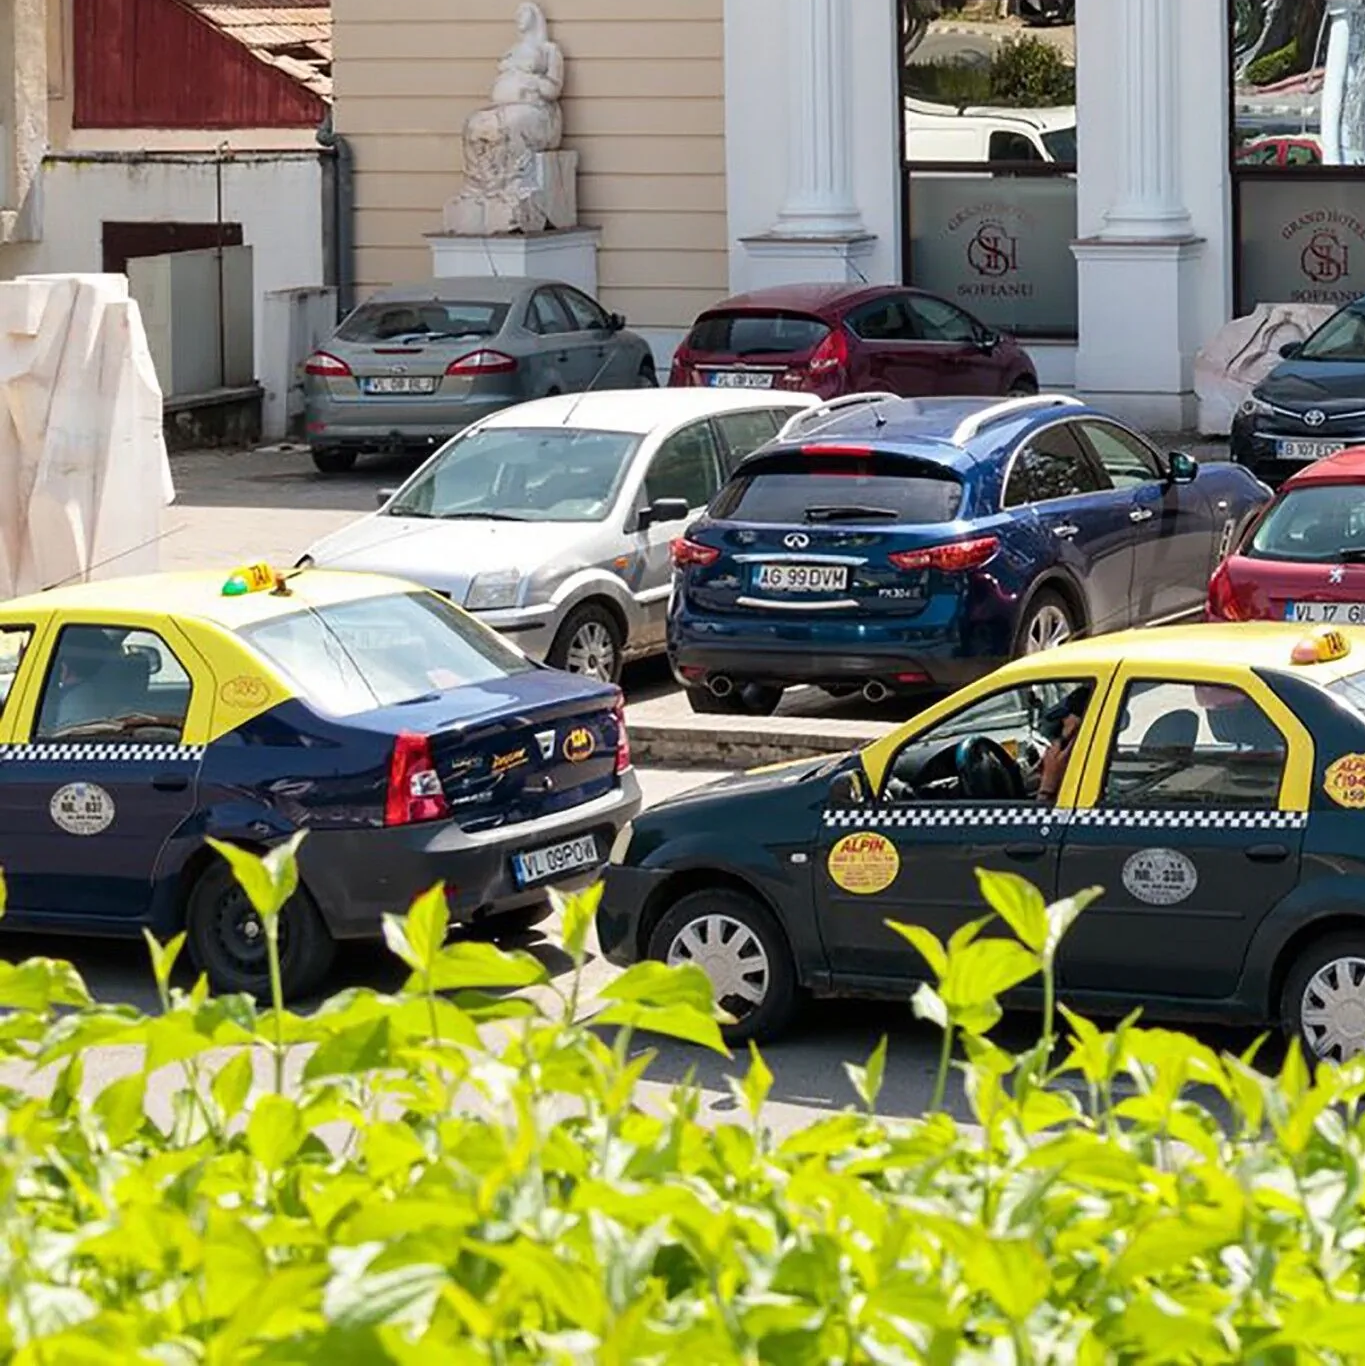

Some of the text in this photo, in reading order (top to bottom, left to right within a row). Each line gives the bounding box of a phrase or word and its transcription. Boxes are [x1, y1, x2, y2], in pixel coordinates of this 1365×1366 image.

[762, 569, 781, 586] AG
[1296, 605, 1315, 622] VL
[1323, 605, 1338, 622] 17
[840, 838, 886, 853] ALPIN
[523, 854, 545, 877] VL
